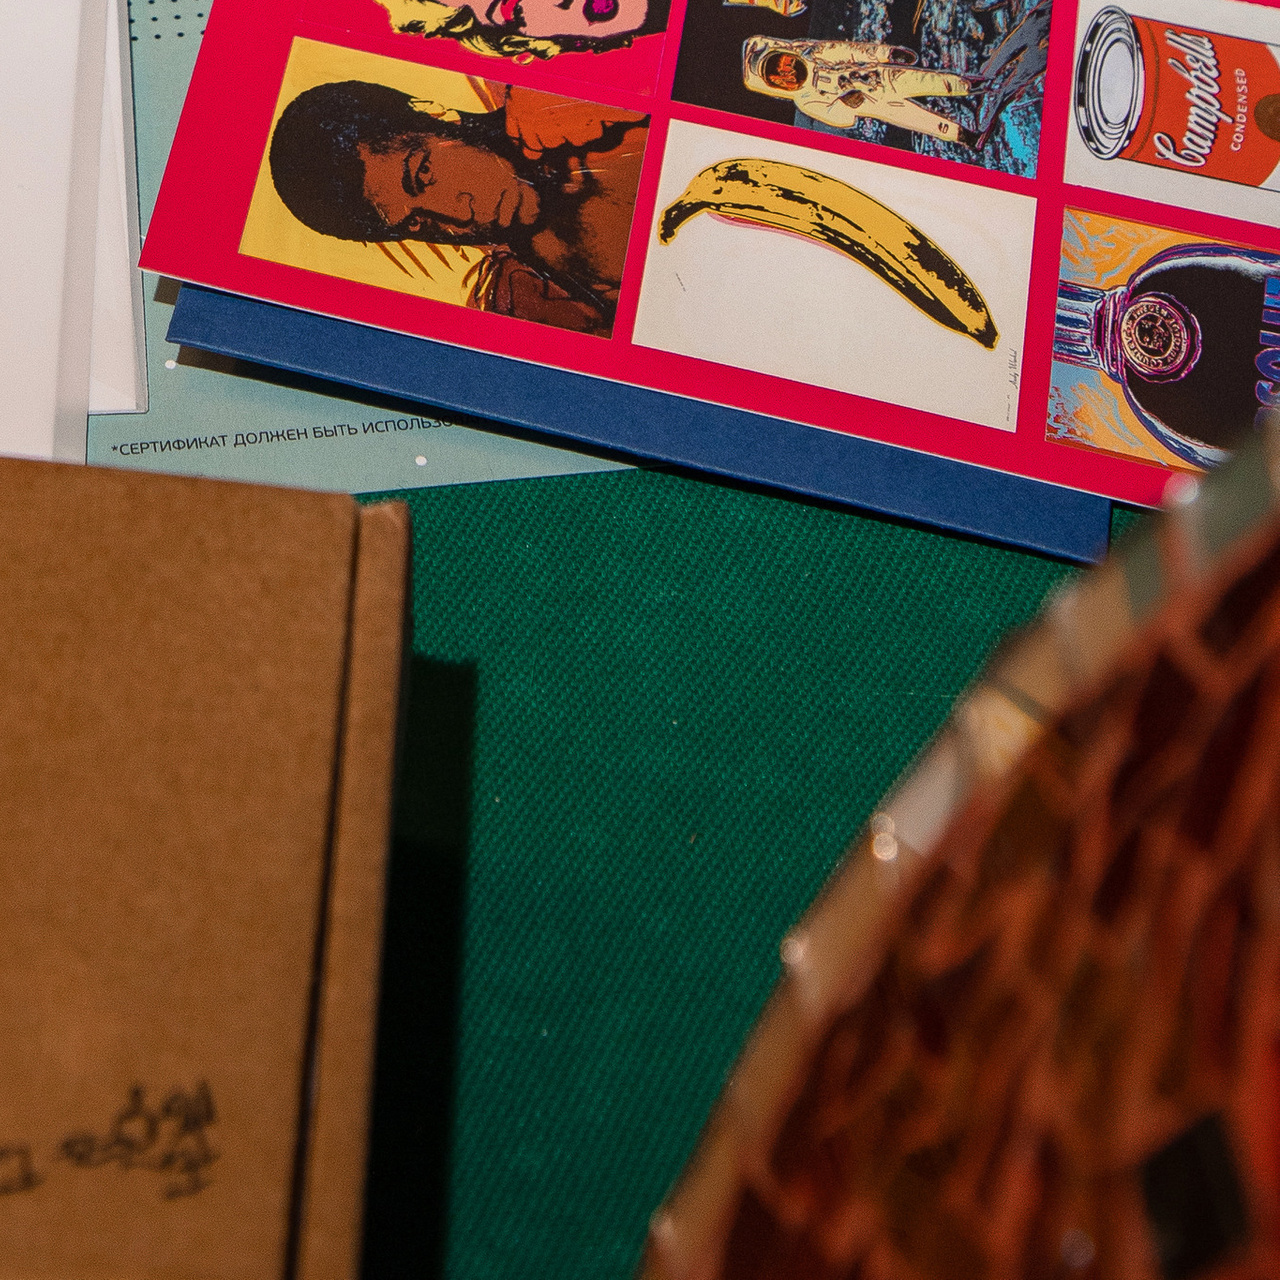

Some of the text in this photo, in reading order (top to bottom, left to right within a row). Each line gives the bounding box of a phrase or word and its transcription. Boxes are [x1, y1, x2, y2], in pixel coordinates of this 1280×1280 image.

[1230, 68, 1248, 151] CONDENSED
[233, 427, 308, 448] ДОЛЖЕН
[313, 422, 359, 439] БЫТЬ
